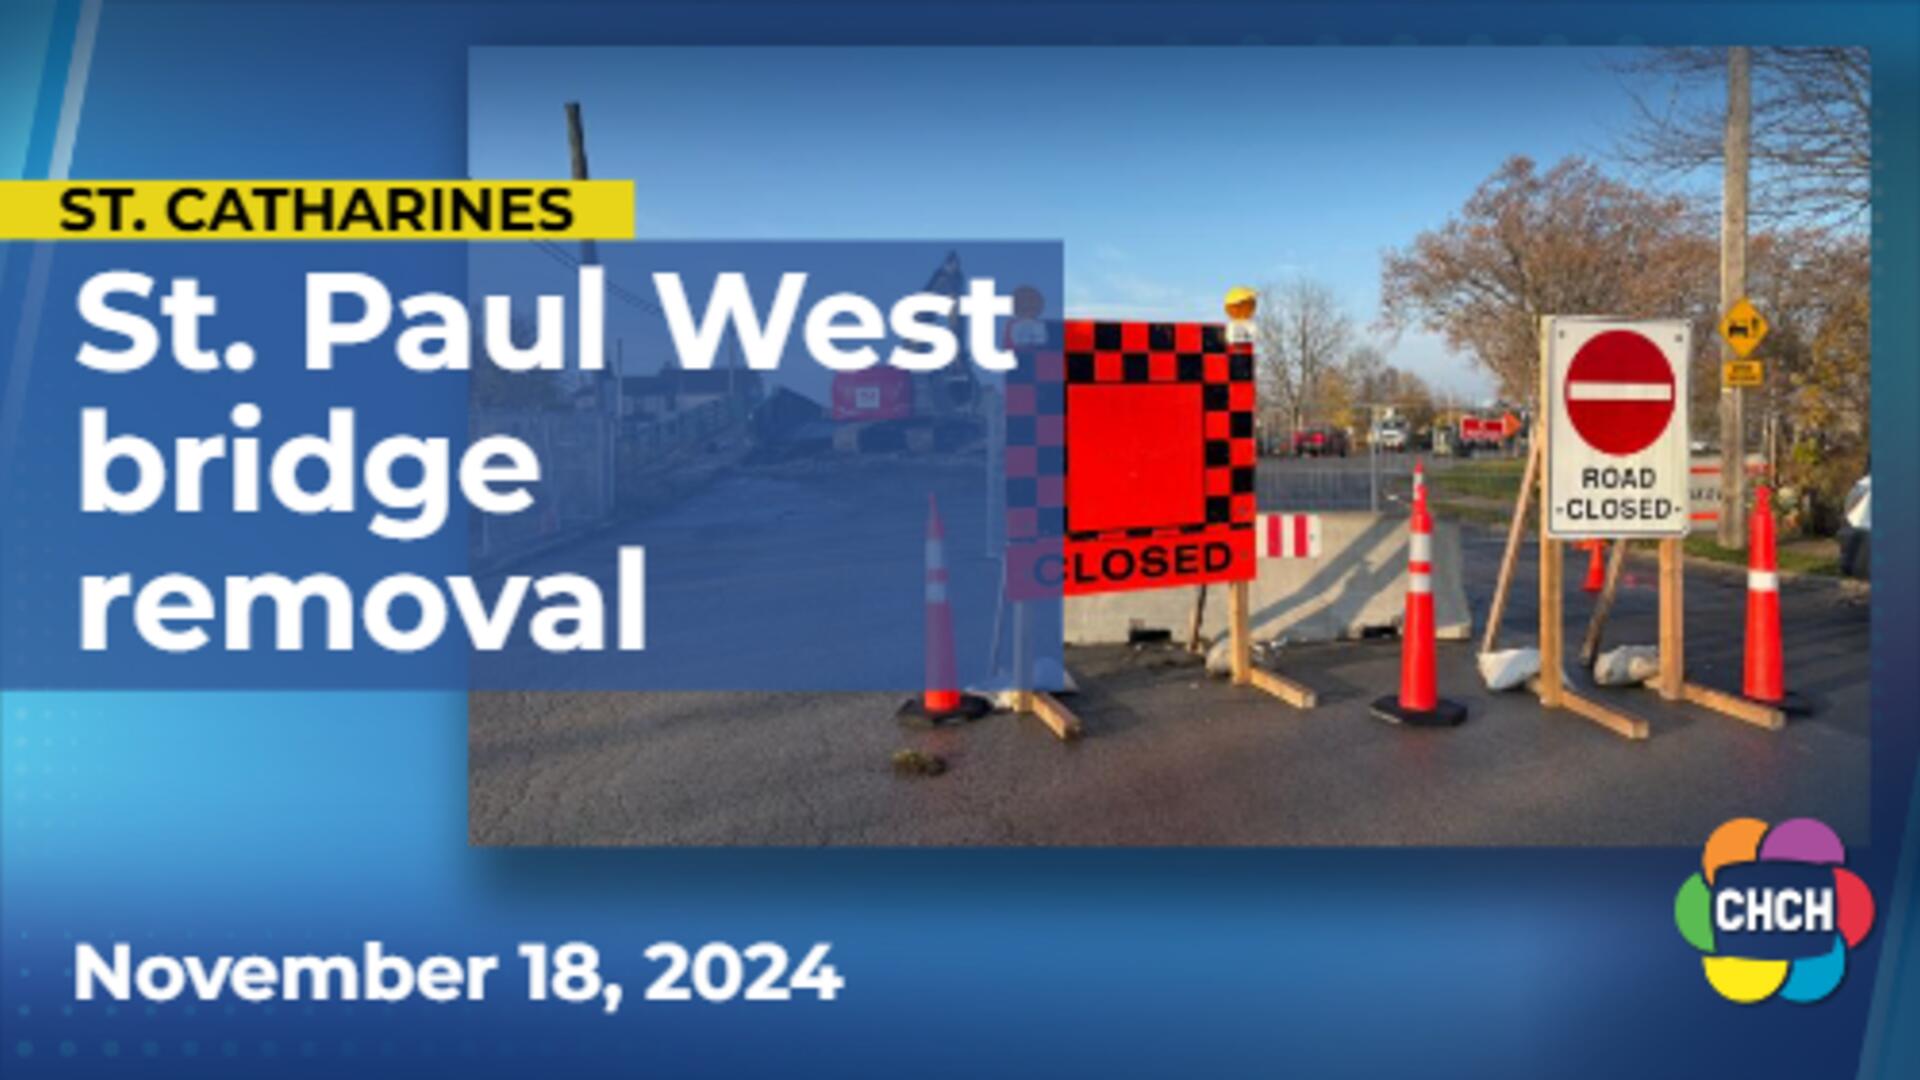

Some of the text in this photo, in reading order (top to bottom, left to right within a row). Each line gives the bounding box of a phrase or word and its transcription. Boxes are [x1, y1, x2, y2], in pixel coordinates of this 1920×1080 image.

[1581, 467, 1656, 489] ROAD
[1566, 498, 1672, 520] CLOSED
[1033, 541, 1232, 587] CLOSED
